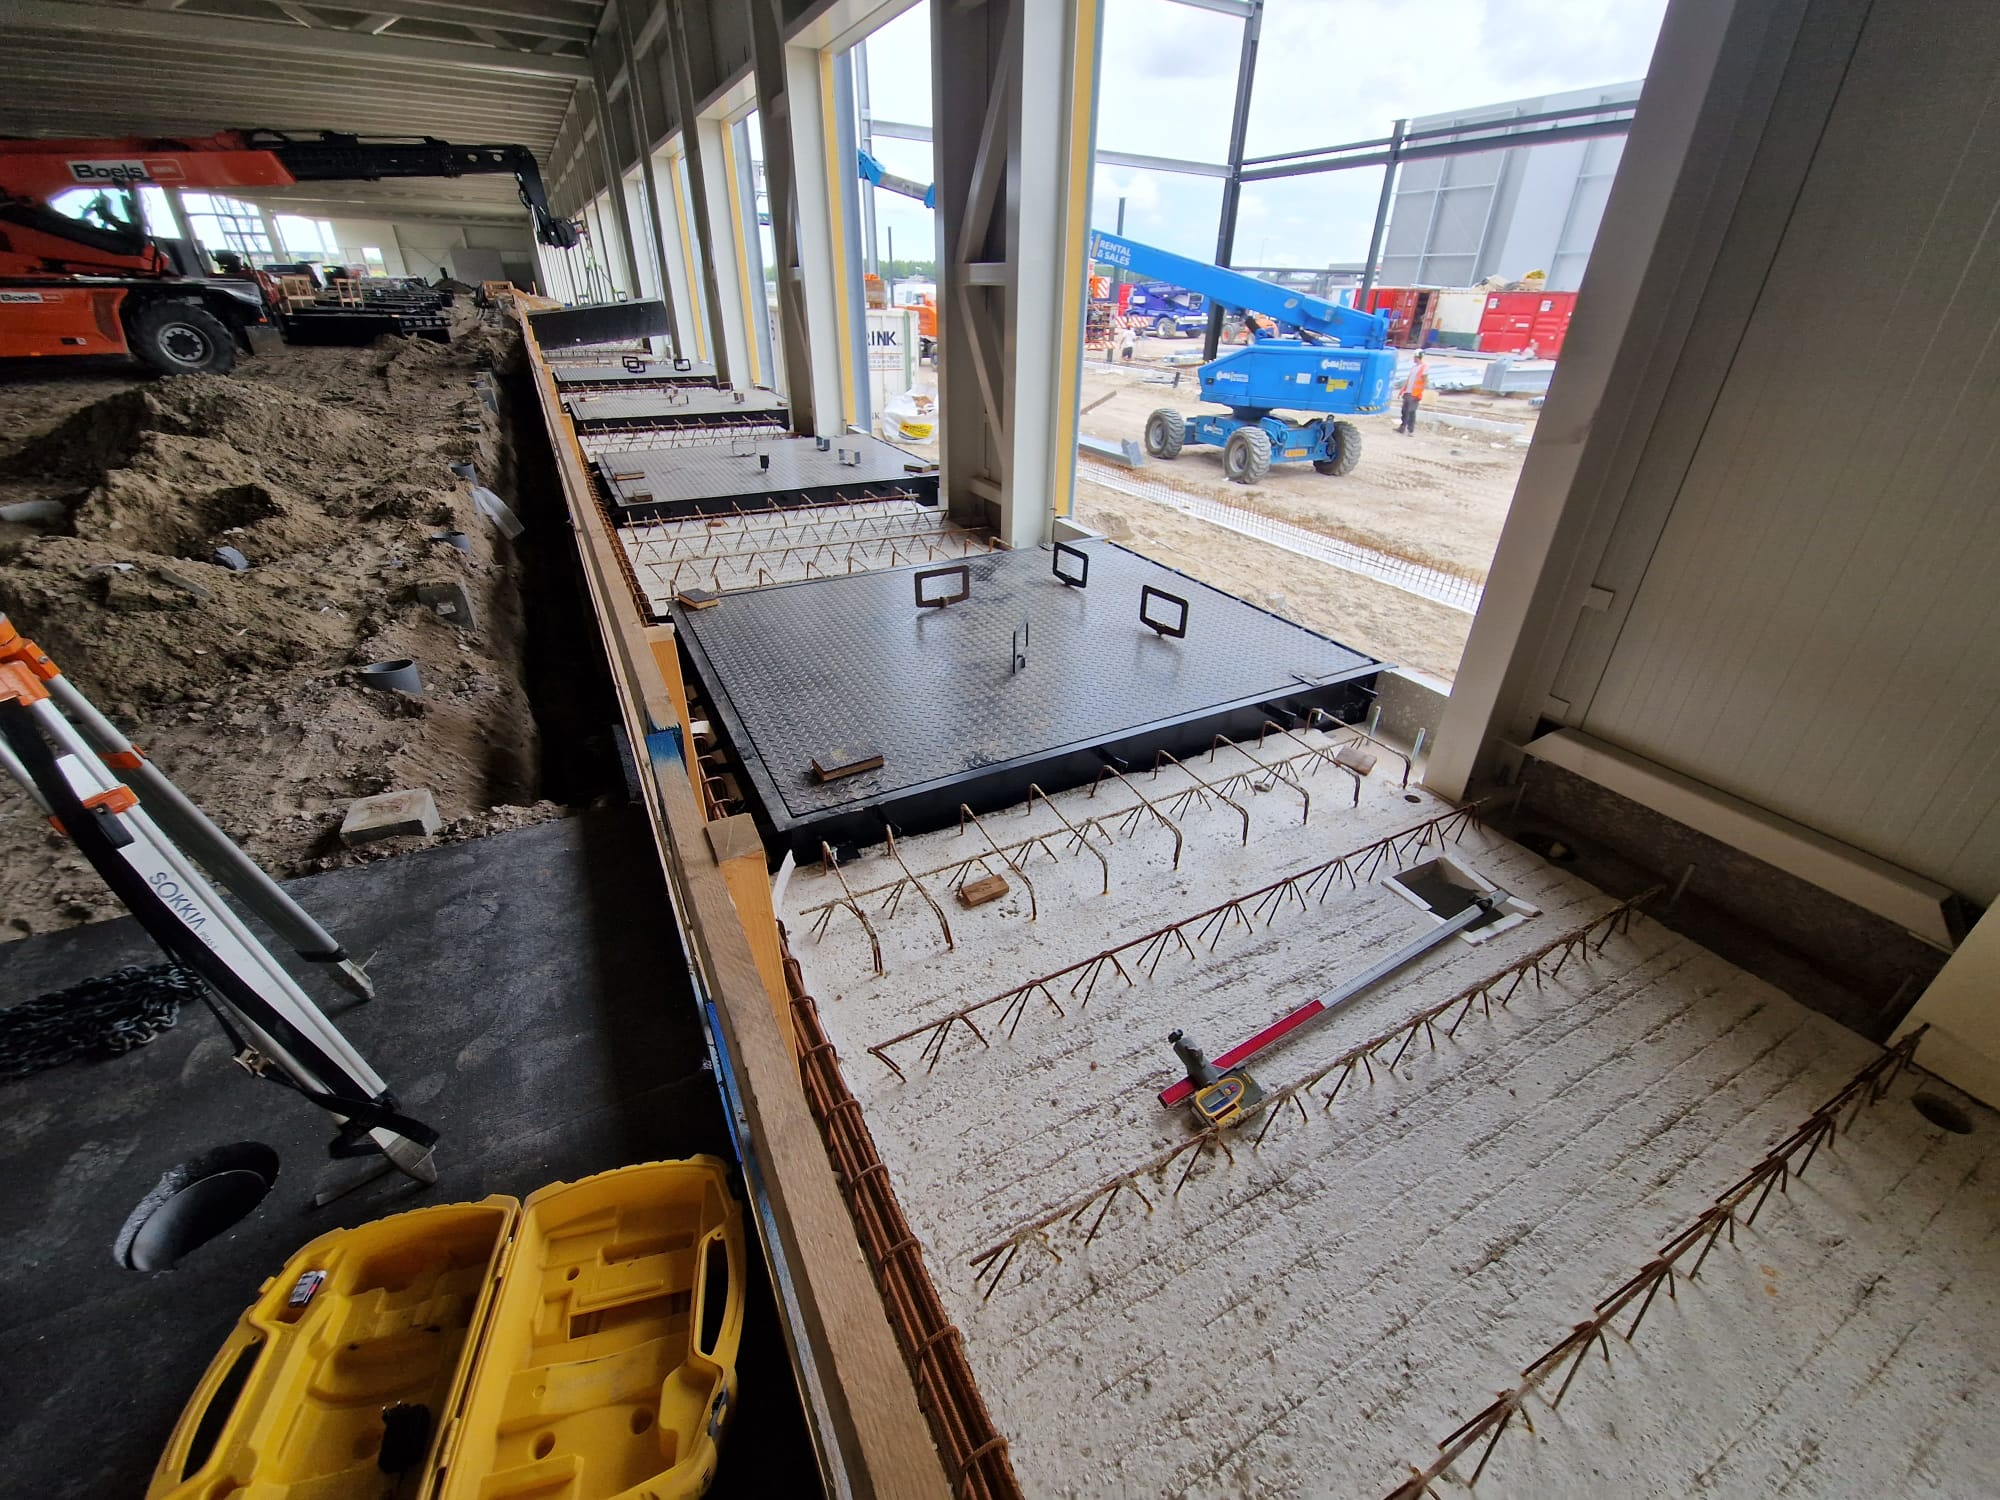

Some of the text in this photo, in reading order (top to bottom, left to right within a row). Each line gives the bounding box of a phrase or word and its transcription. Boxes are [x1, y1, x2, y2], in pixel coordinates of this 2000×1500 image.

[72, 164, 144, 178] Boels
[1100, 240, 1131, 257] RENTAL
[1104, 251, 1130, 265] SALES
[868, 331, 897, 346] INK
[149, 872, 206, 930] SOKKIA
